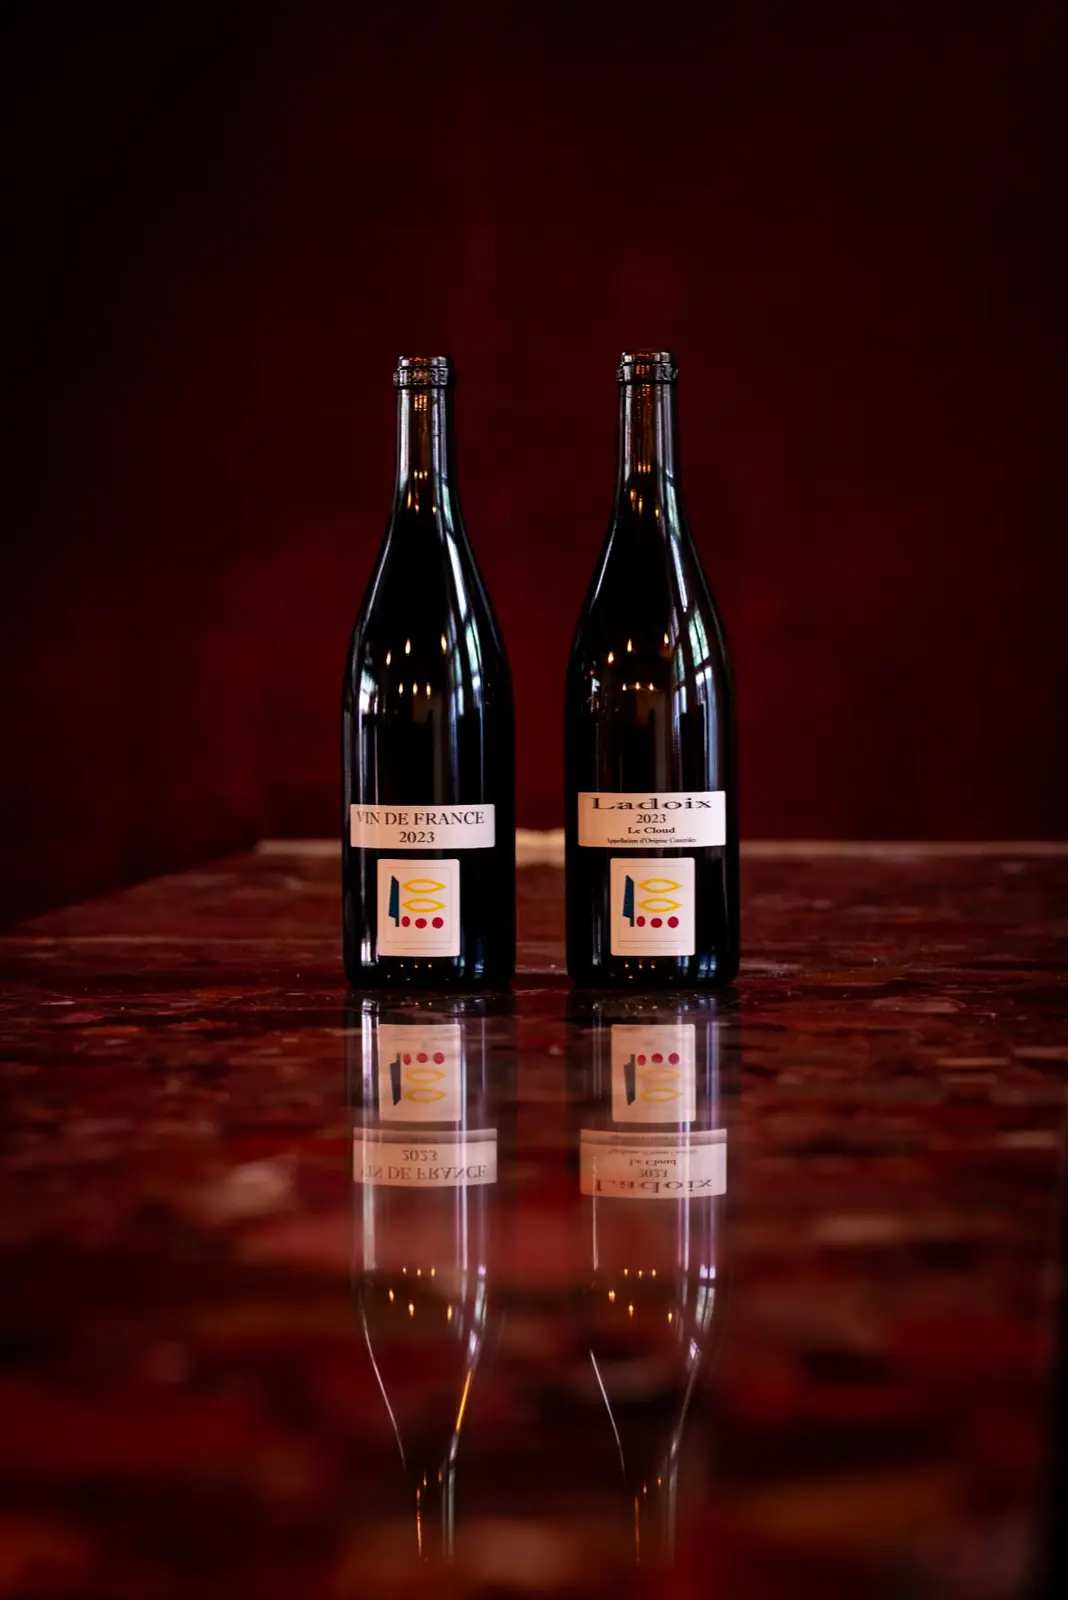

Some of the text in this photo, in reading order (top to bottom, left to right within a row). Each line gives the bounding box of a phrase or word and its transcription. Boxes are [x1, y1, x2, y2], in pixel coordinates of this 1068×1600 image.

[592, 797, 712, 810] Ladoix
[357, 811, 485, 825] VIN DE FRANCE
[636, 814, 666, 824] 2023
[399, 831, 435, 843] 2023
